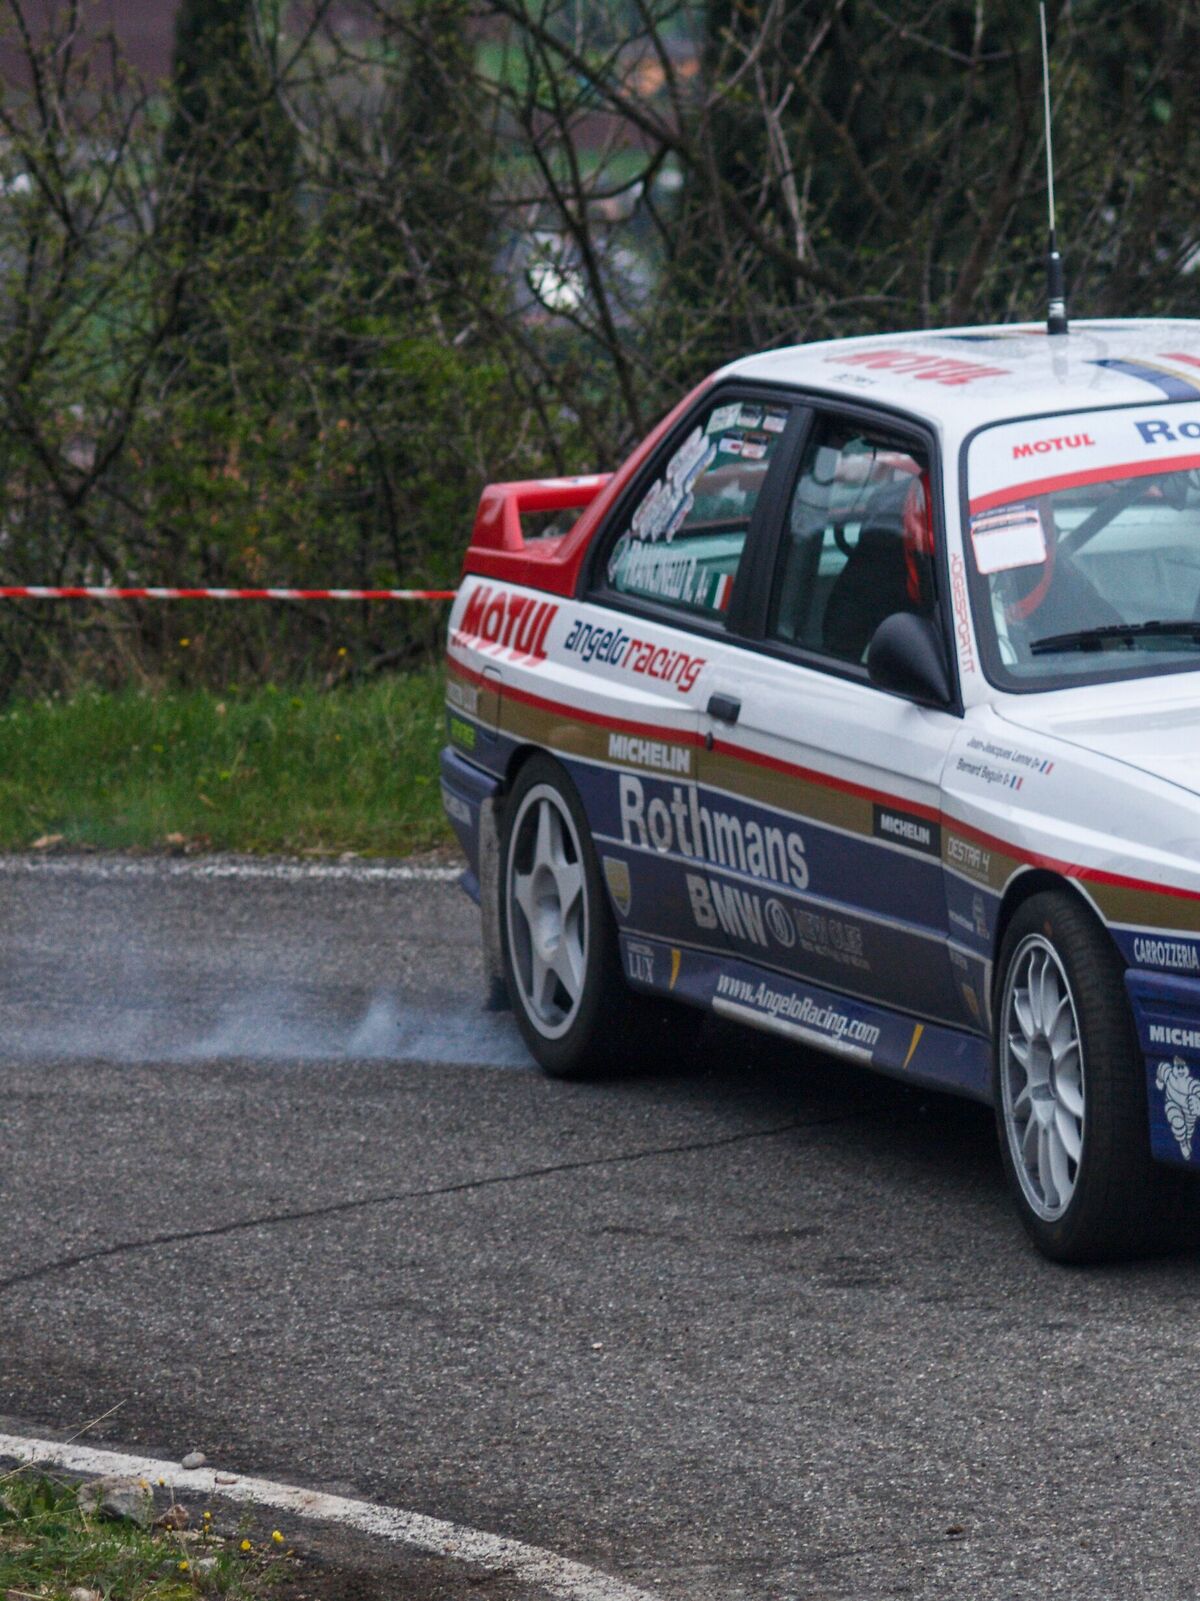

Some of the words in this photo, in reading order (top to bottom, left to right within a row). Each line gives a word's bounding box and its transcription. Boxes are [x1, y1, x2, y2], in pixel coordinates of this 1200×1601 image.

[1013, 434, 1095, 459] MOTUL
[452, 584, 559, 667] MOTUL
[609, 733, 690, 773] MICHELIN
[956, 758, 982, 777] Bernard
[619, 774, 809, 889] Rothmans
[881, 813, 930, 845] MICHELIN
[686, 873, 768, 946] BMW
[627, 951, 655, 984] LUX
[1133, 937, 1200, 970] CARROZZERIA
[716, 974, 880, 1045] www.AngeloRacing.com
